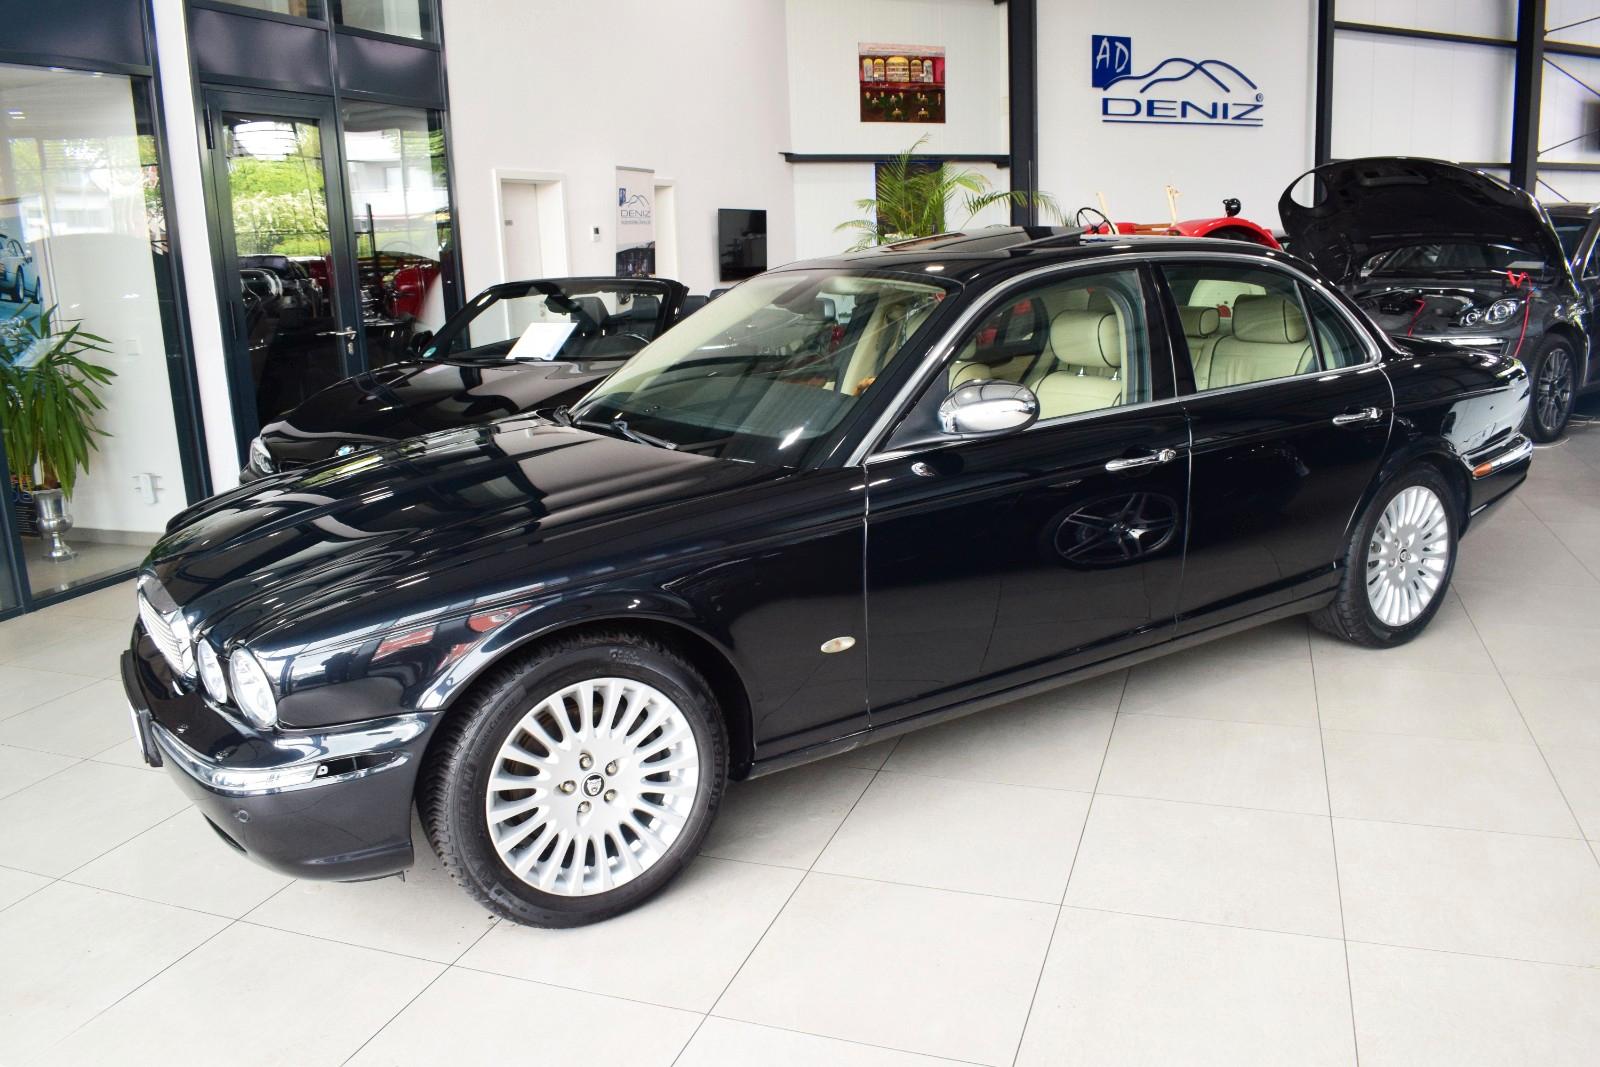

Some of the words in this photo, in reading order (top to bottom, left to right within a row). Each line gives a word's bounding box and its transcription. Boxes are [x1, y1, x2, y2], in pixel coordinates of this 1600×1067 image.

[1095, 37, 1129, 73] AD
[1102, 97, 1264, 121] DENIZ
[620, 209, 651, 217] DENIZ
